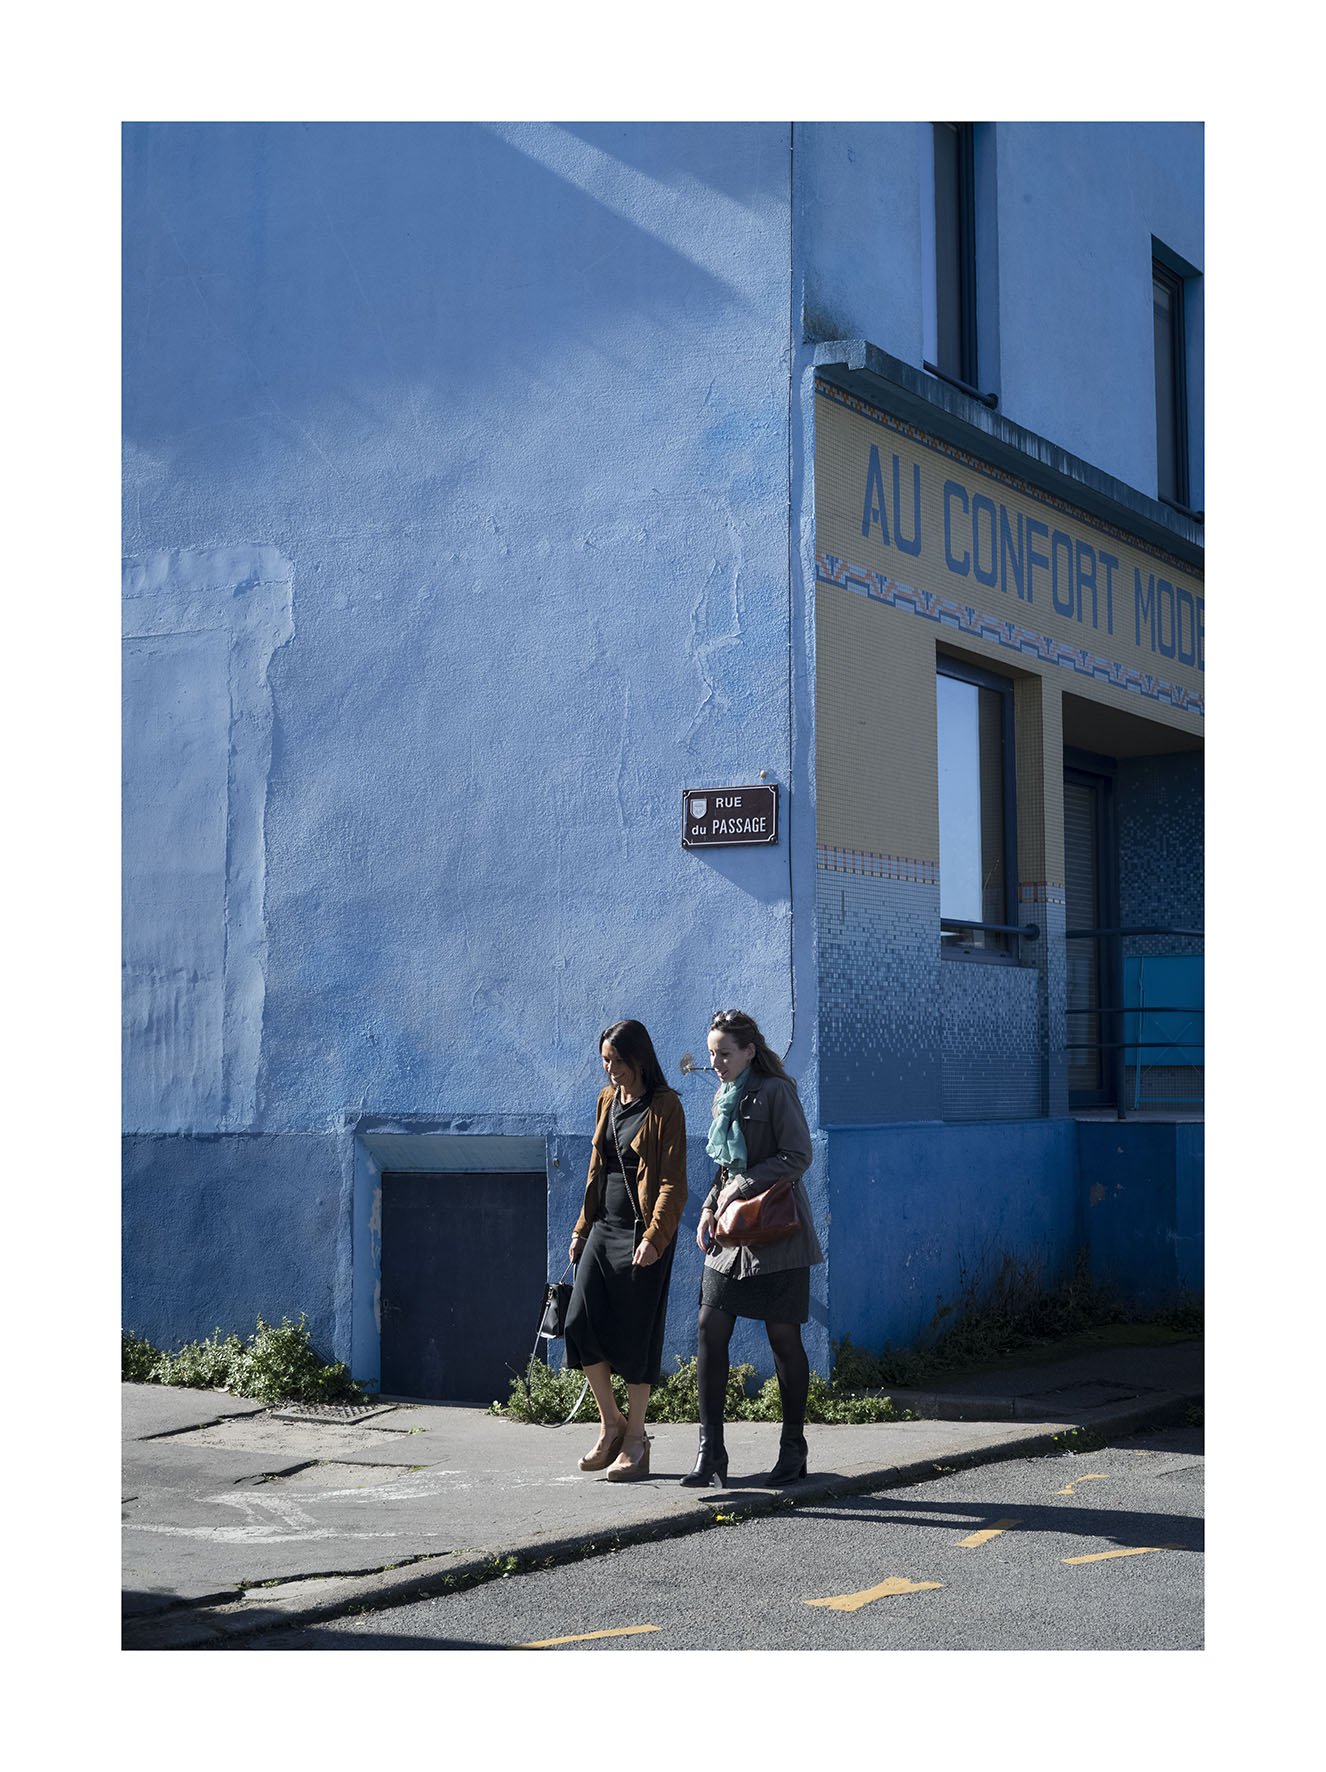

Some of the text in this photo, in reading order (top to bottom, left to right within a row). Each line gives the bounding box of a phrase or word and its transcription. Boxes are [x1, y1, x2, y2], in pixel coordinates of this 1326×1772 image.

[862, 443, 922, 557] AU
[943, 479, 1119, 635] CONFORT
[715, 797, 742, 808] RUE
[691, 817, 766, 835] du PASSAGE
